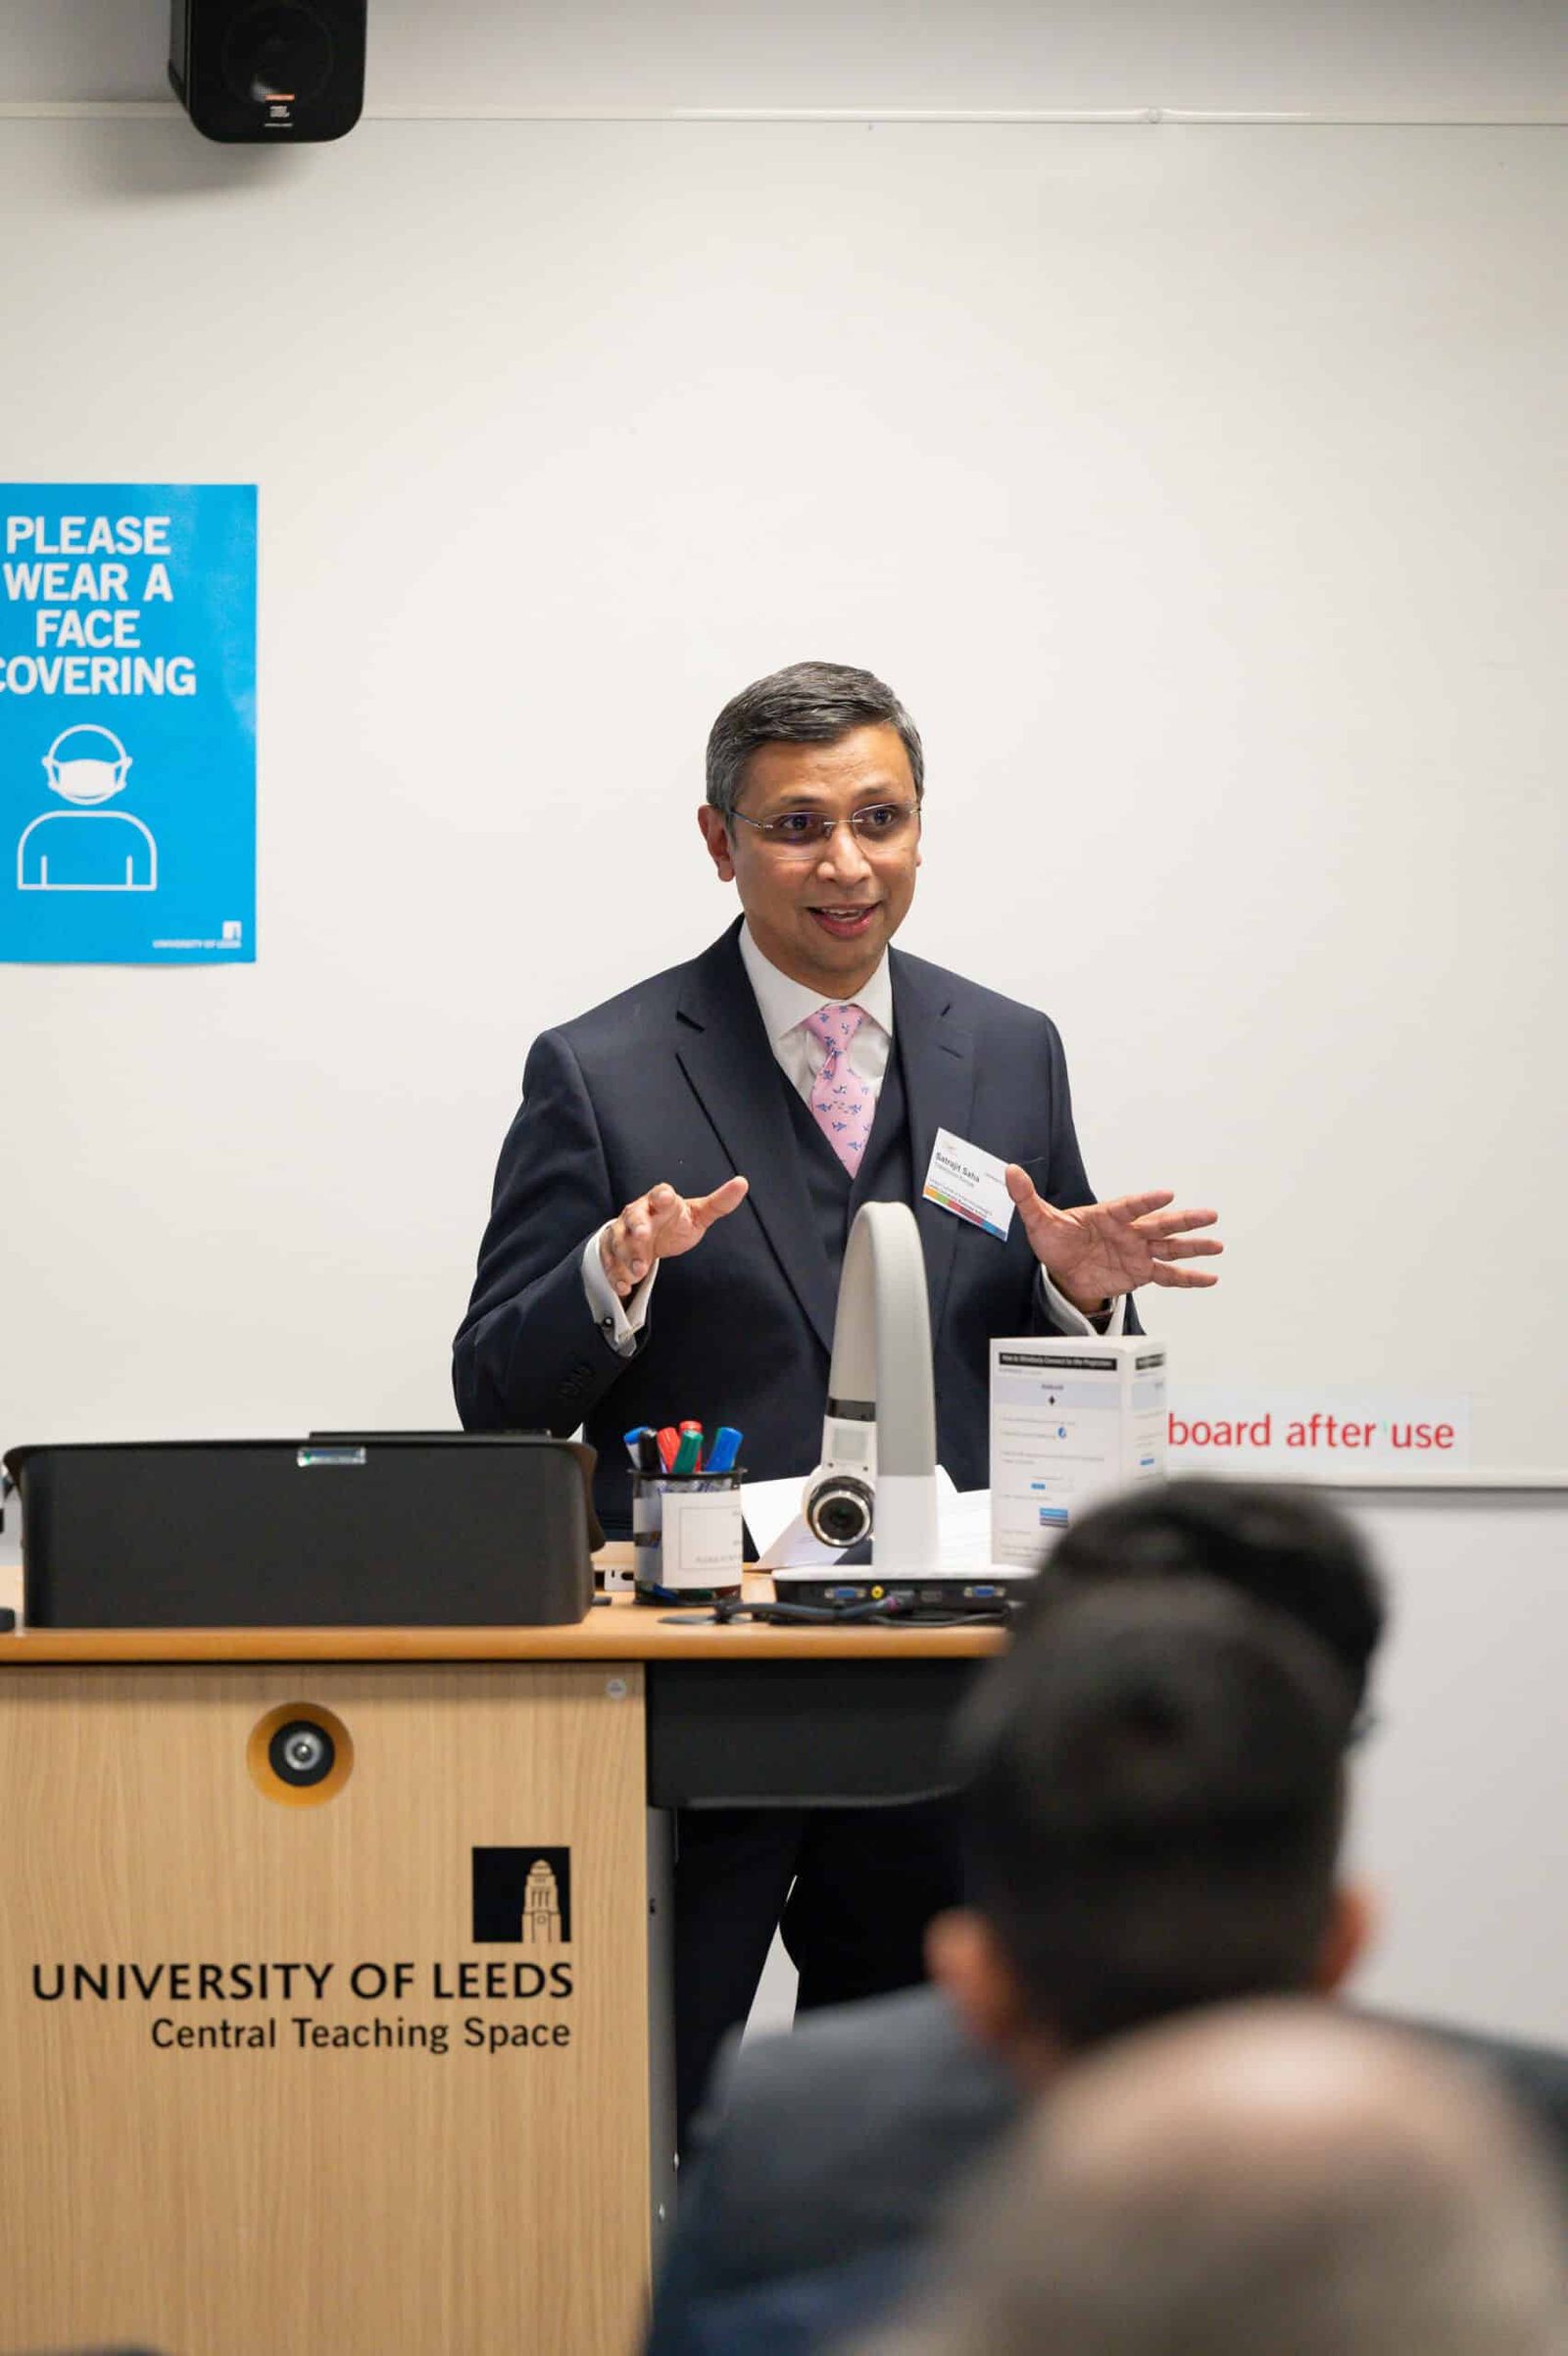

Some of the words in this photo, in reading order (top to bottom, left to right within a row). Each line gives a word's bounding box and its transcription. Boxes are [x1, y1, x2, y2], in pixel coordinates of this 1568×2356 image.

[7, 515, 172, 556] PLEASE
[3, 563, 129, 602] WEAR
[142, 563, 173, 602] A
[36, 609, 141, 649] FACE
[0, 655, 197, 696] OVERING
[1167, 1412, 1271, 1447] board
[1286, 1413, 1375, 1448] after
[1391, 1424, 1455, 1449] use
[32, 1963, 334, 2001] UNIVERSITY
[350, 1962, 415, 2000] OF
[433, 1962, 573, 1999] LEEDS
[151, 2017, 275, 2049] Central
[291, 2017, 449, 2055] Teaching
[464, 2016, 570, 2055] Space
